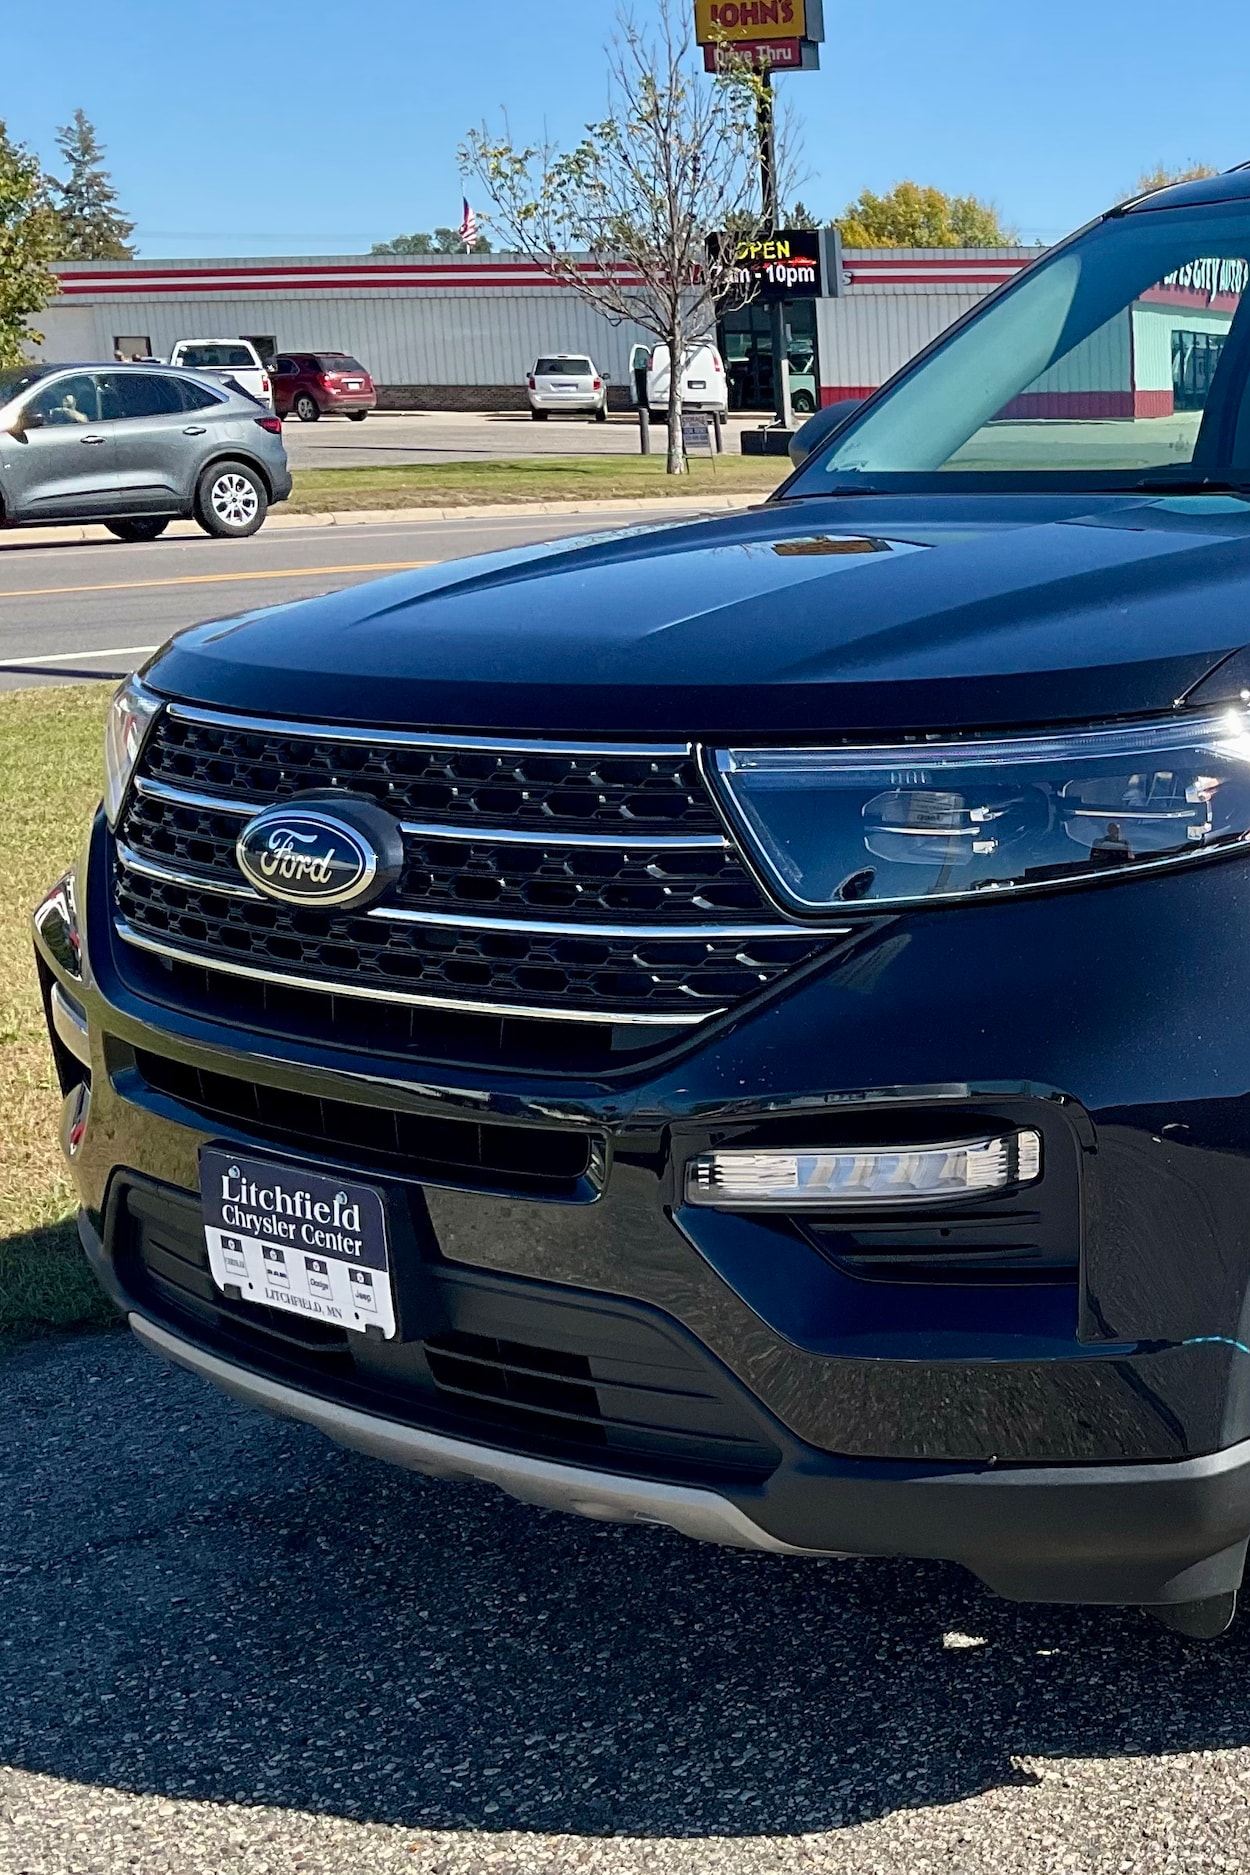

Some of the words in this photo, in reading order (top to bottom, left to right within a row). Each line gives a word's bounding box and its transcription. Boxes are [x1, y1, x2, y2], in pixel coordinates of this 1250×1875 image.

[755, 46, 792, 61] Thru
[737, 240, 790, 259] OPEN
[765, 264, 815, 287] 10pm
[260, 828, 335, 883] Ford
[221, 1175, 361, 1232] Litchfield
[222, 1203, 296, 1239] Chrysler
[301, 1223, 362, 1256] Center
[310, 1278, 329, 1291] Dodge
[355, 1289, 372, 1303] Jeep
[265, 1287, 325, 1315] LITCHFIELD,
[326, 1305, 343, 1319] MN
